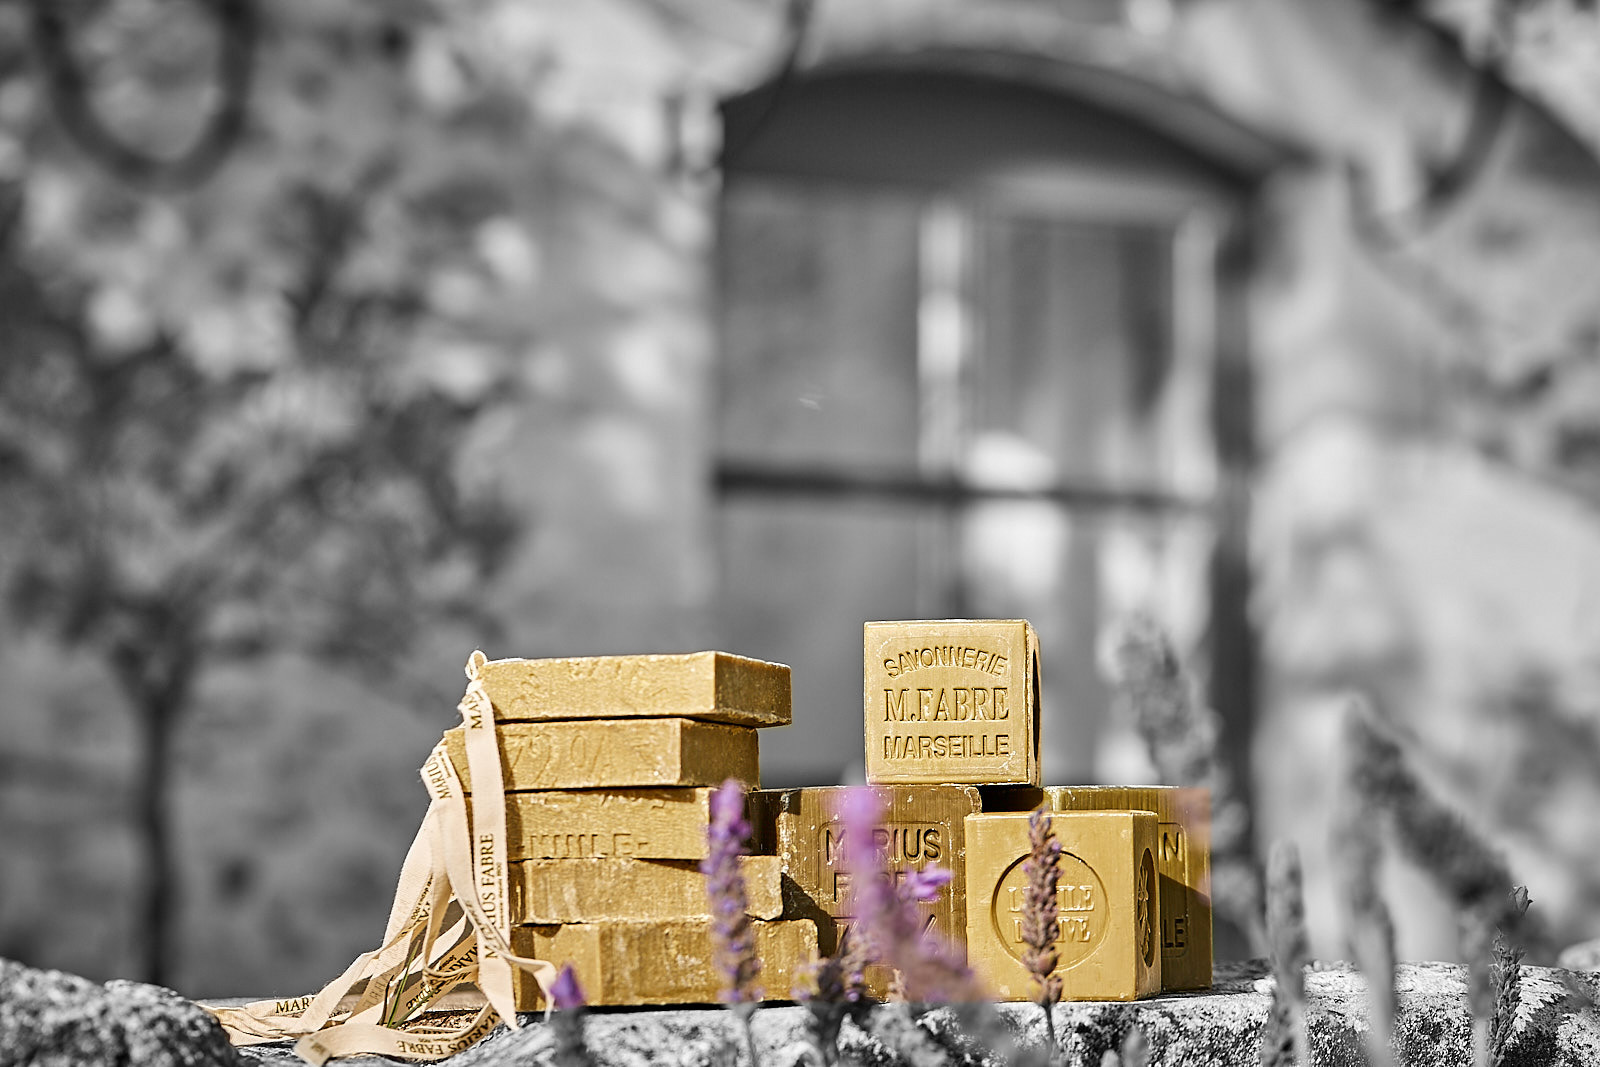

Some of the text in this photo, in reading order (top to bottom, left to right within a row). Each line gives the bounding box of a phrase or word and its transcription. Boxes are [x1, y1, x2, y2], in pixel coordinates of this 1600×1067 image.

[883, 645, 1008, 678] SAVONNERIE
[883, 687, 1009, 722] M.FABRE
[883, 735, 1010, 760] MARSEILLE
[826, 828, 942, 862] MRIUS
[480, 833, 499, 959] MIUS FABRE
[396, 1011, 500, 1055] MARIUS FABRE
